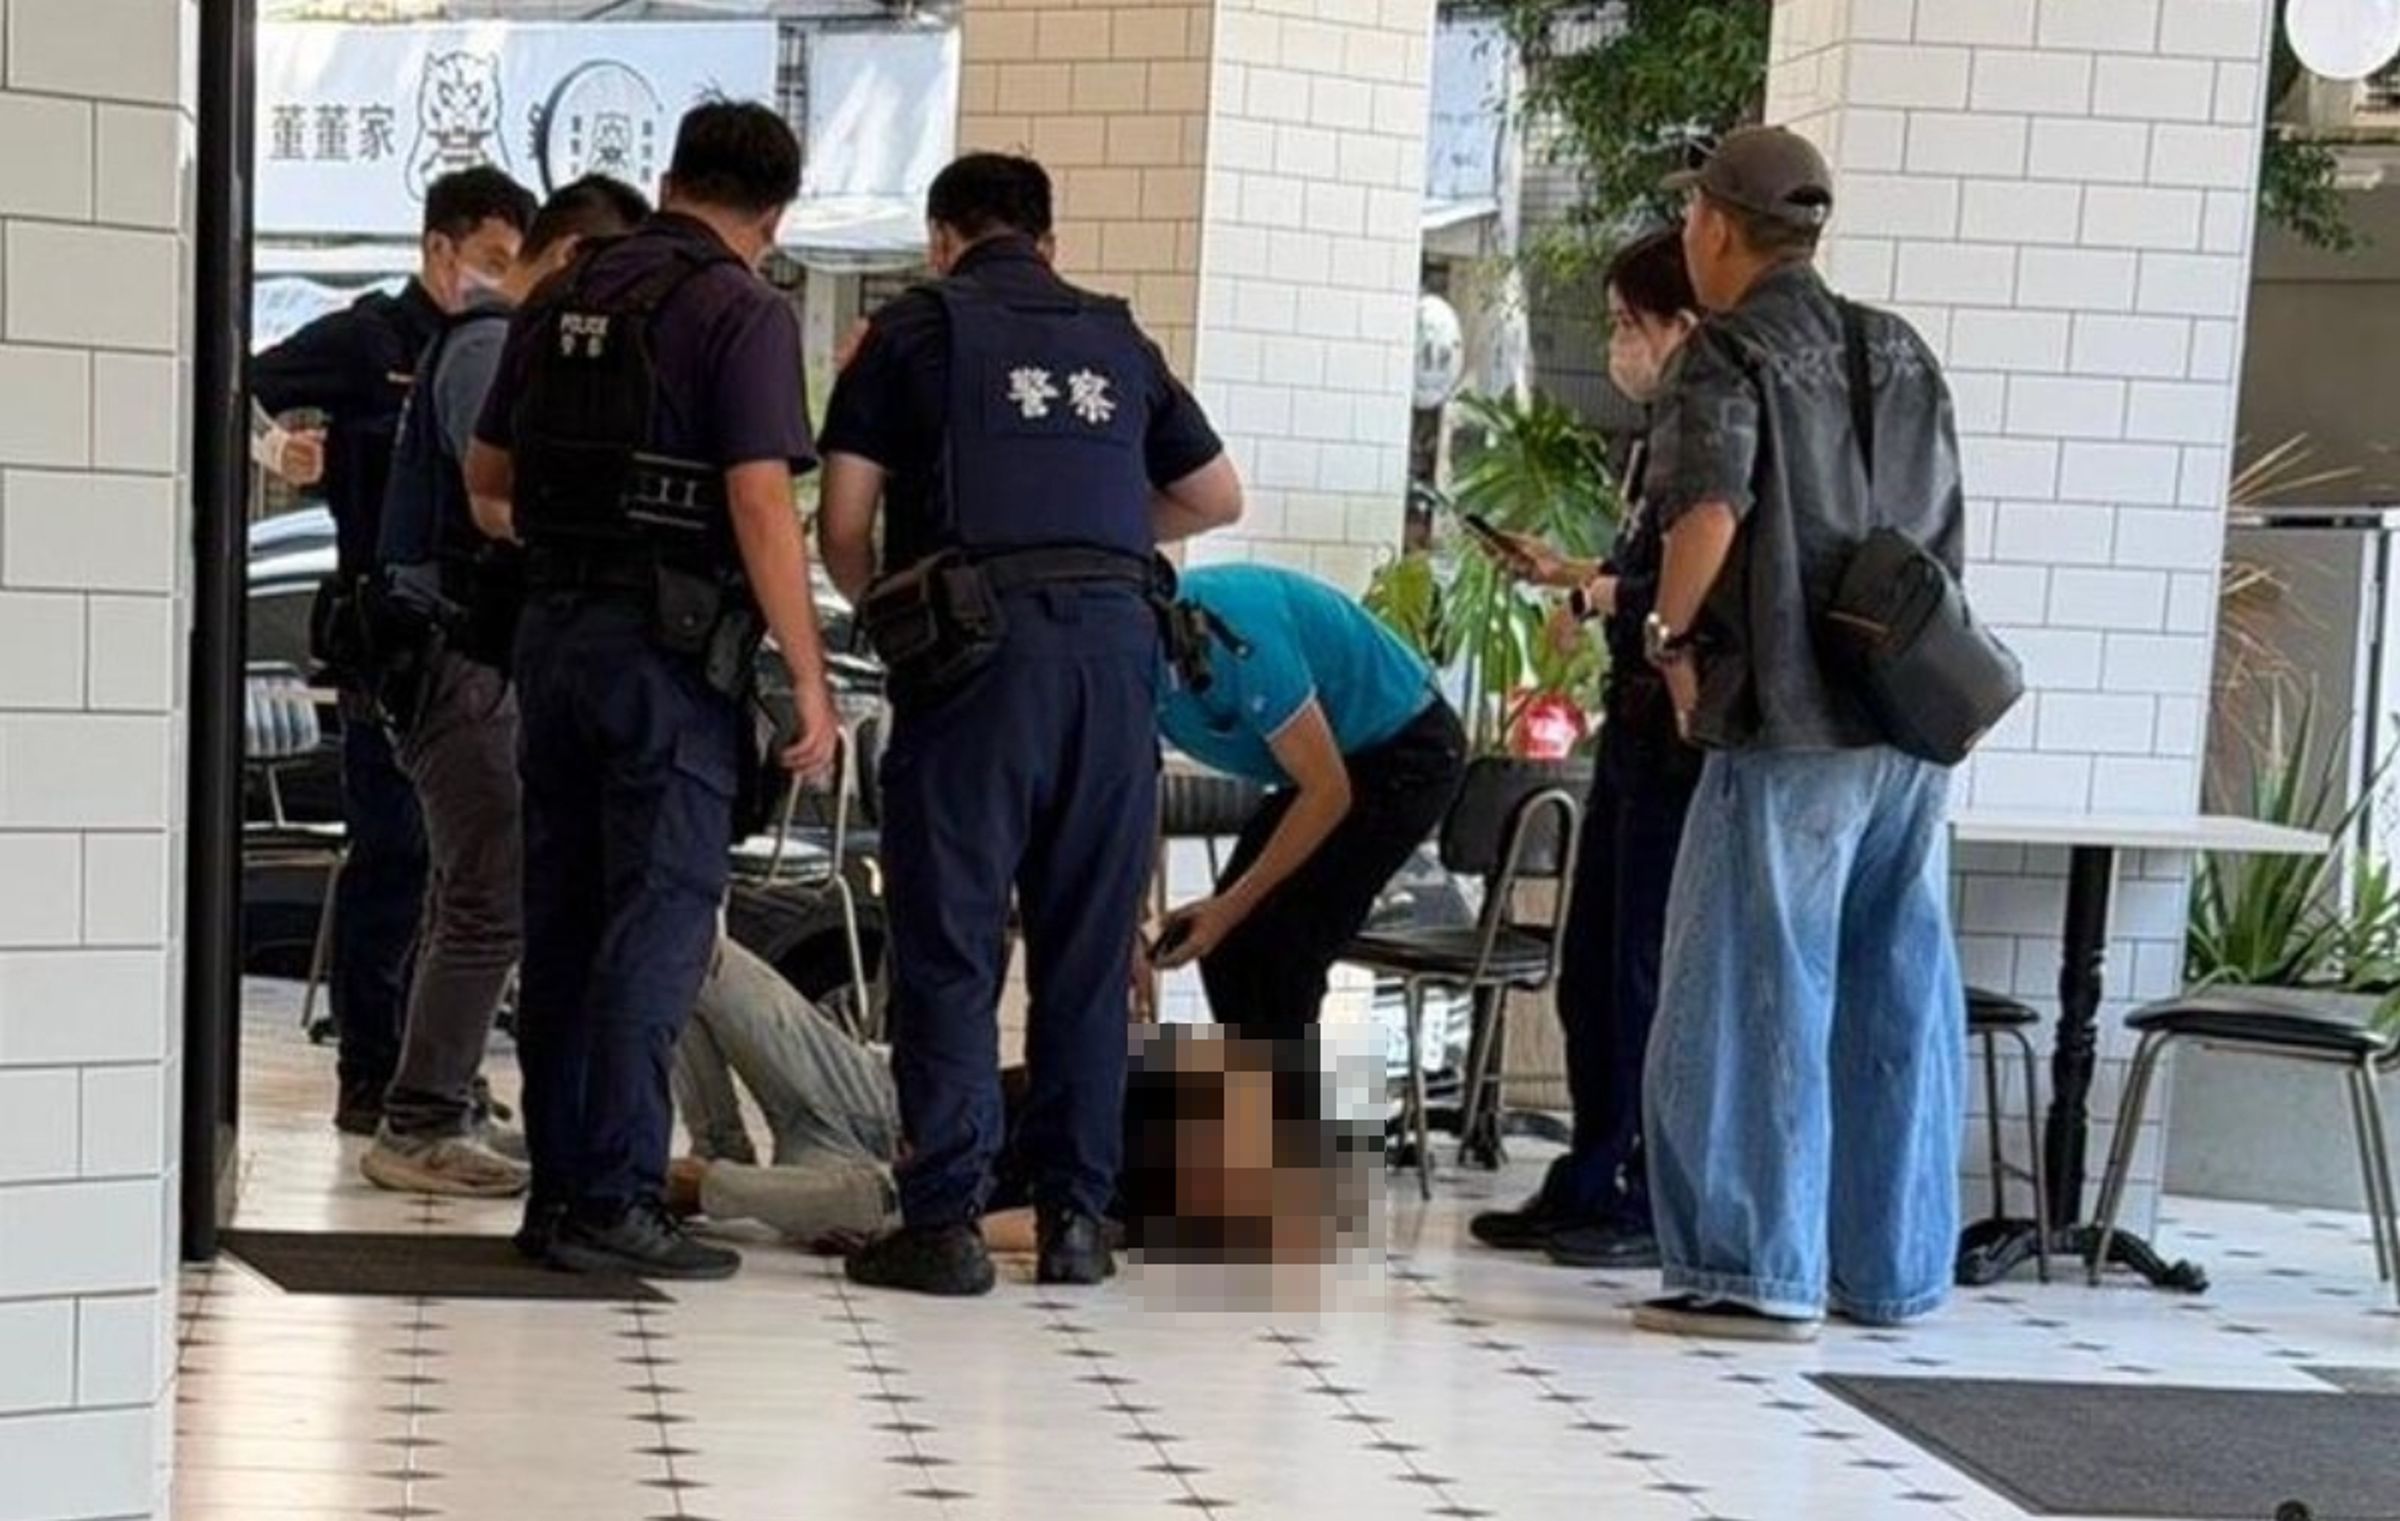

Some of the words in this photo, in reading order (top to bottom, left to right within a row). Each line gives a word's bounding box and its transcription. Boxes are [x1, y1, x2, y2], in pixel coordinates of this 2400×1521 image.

[269, 102, 395, 160] 董董家
[1008, 367, 1116, 422] 警察
